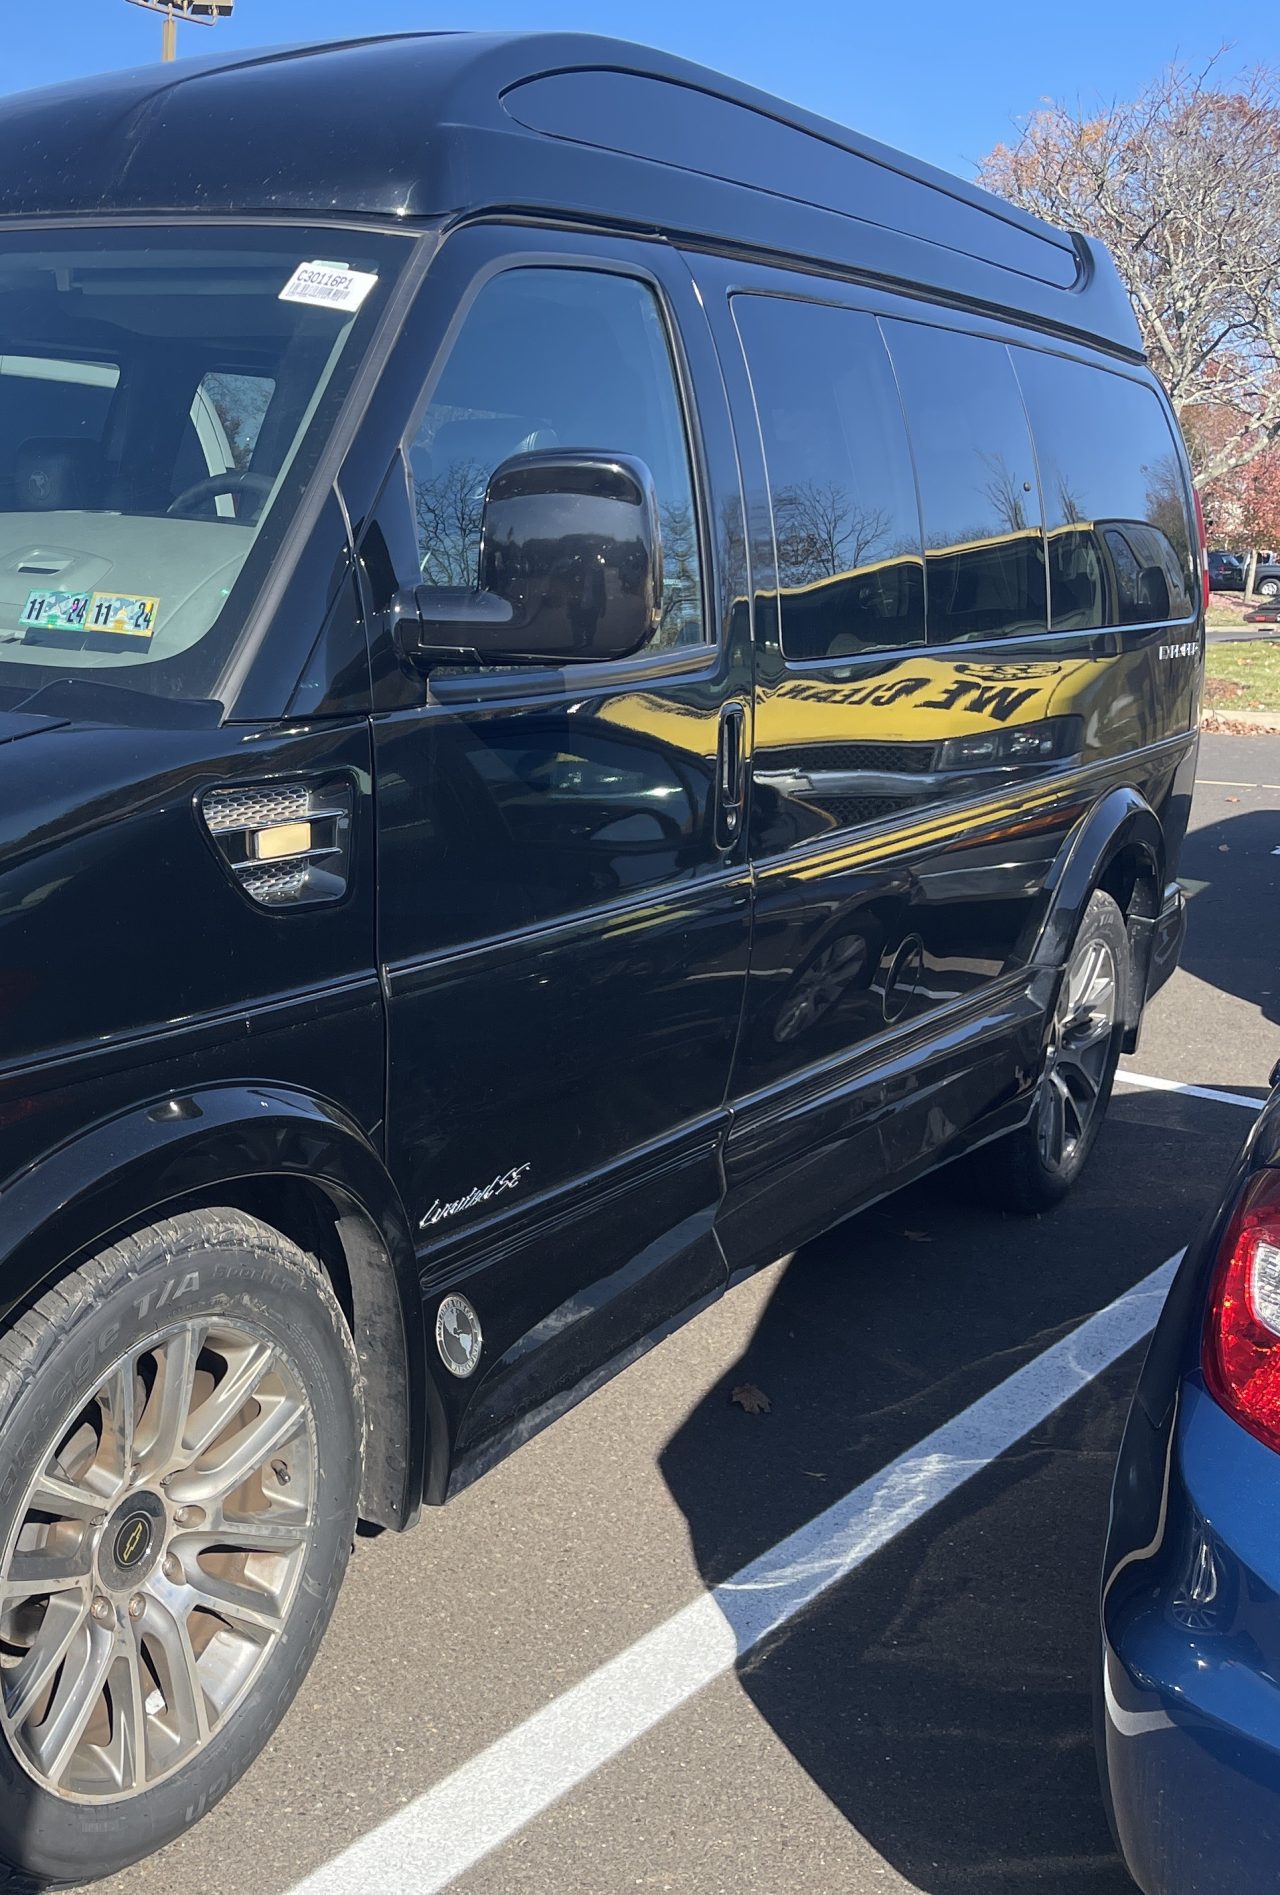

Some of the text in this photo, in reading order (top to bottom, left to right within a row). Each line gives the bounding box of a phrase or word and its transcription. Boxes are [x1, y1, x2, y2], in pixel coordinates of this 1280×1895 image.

[297, 270, 354, 290] C30116P1
[26, 598, 89, 624] 11 24
[93, 601, 154, 630] 11 24
[132, 1270, 201, 1323] T/A
